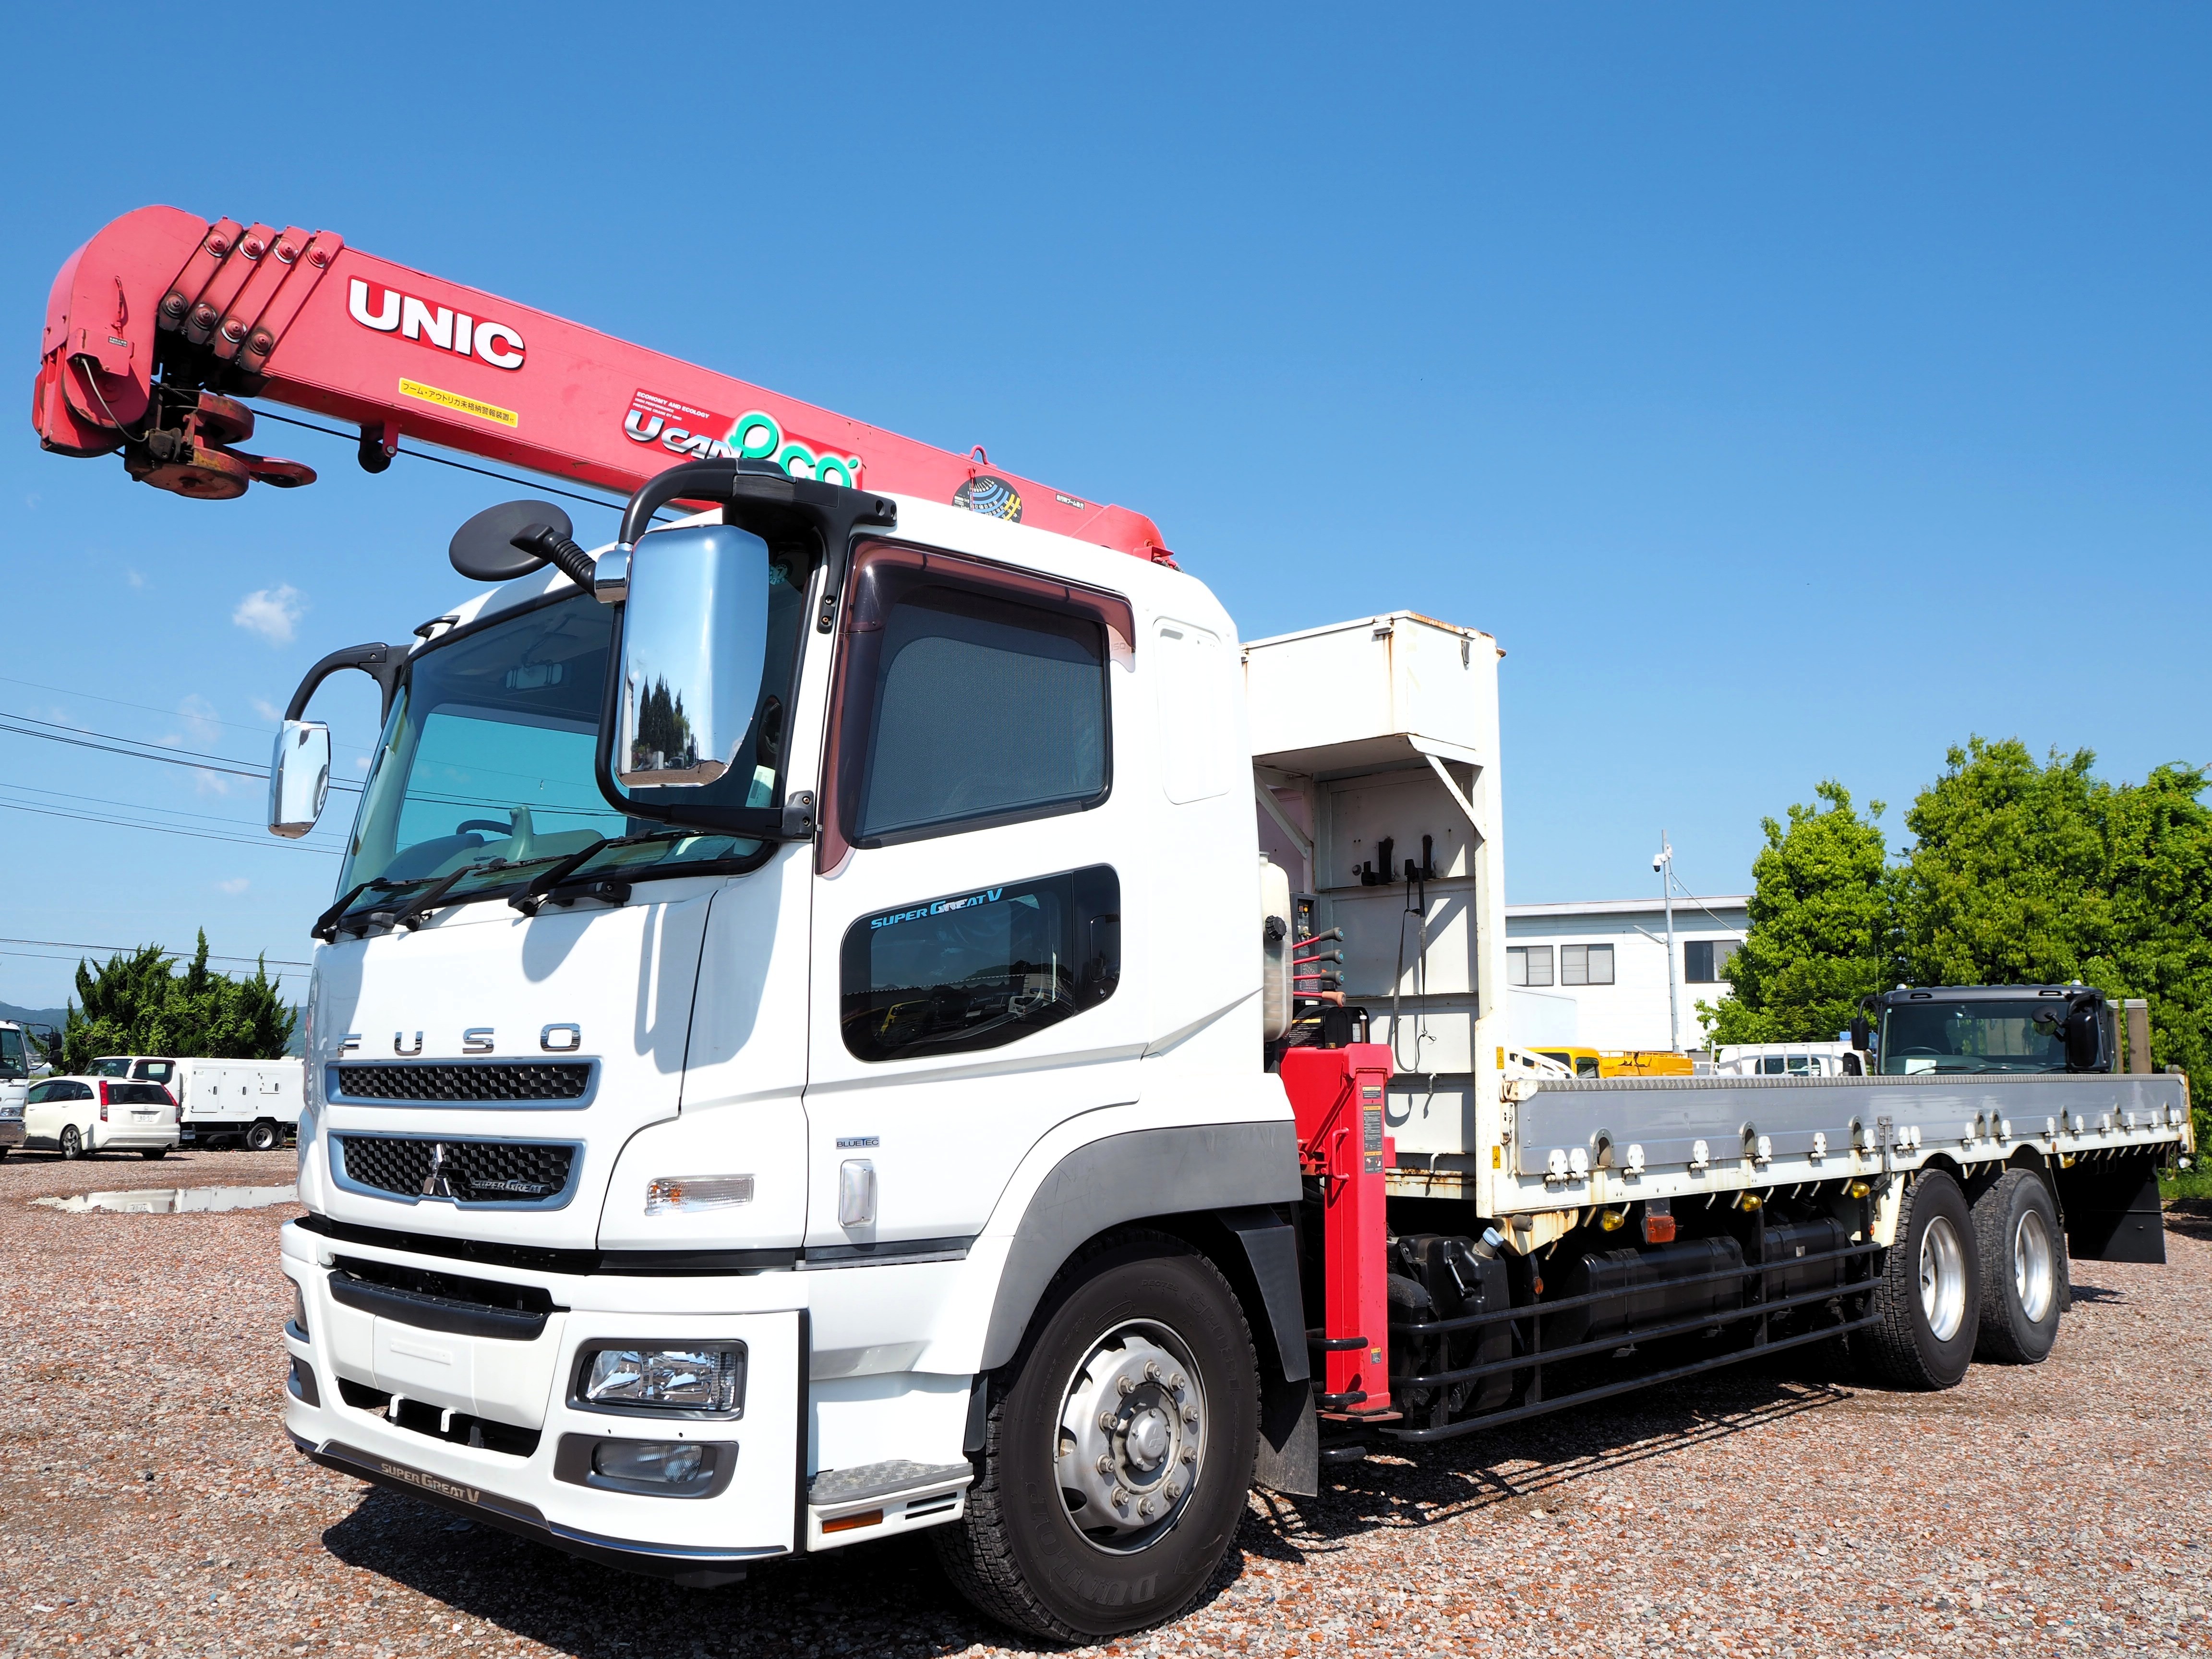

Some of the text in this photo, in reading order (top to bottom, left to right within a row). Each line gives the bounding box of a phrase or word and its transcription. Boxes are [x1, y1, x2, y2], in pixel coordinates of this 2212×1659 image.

[349, 278, 525, 370] UNIC
[637, 391, 710, 419] ECONOMY AND ECOLOGY
[871, 888, 1003, 930] SUPER GREAT V
[337, 1023, 581, 1057] FUSO
[837, 1138, 879, 1147] BLUETEC
[471, 1179, 546, 1194] SUPER GREAT
[381, 1463, 480, 1503] SUPER GREAT V
[1025, 1481, 1159, 1606] DUNLOP
